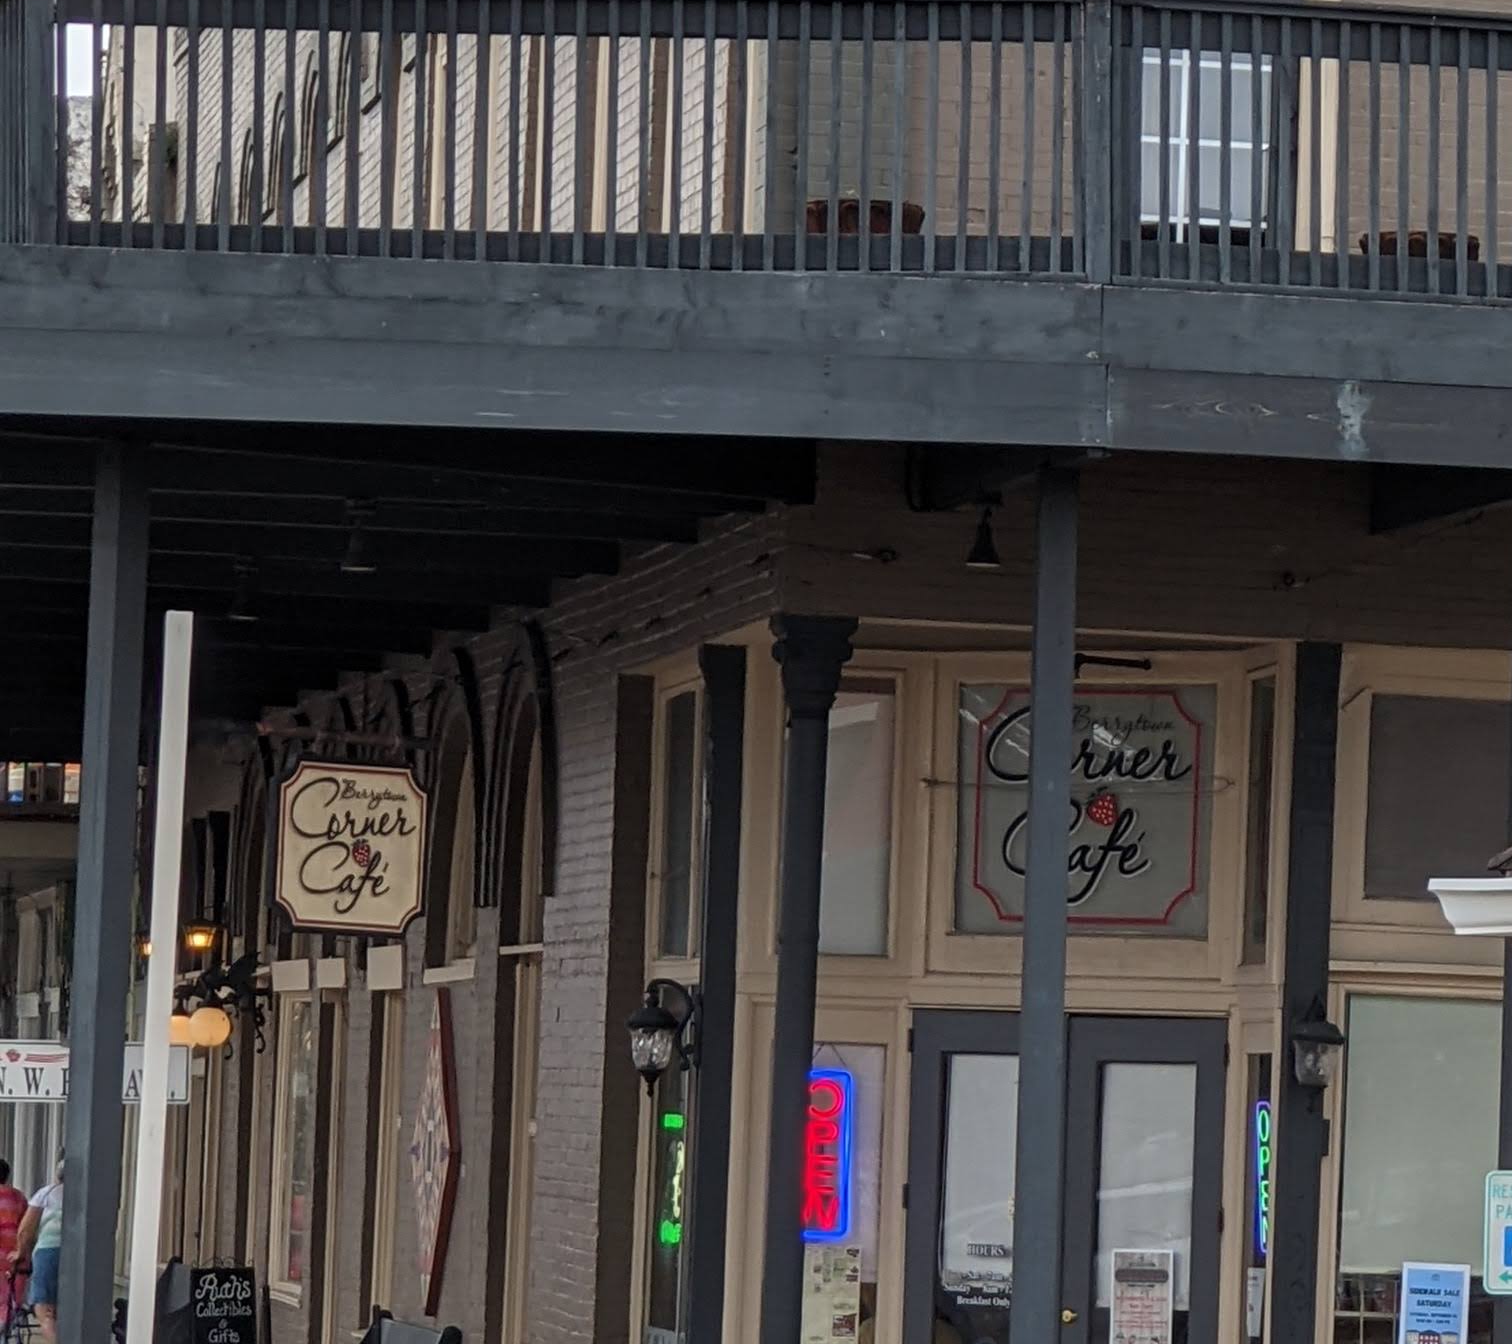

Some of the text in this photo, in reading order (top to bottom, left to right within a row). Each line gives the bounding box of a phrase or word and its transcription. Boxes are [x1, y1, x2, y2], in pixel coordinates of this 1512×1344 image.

[986, 705, 1194, 784] Crner
[290, 776, 417, 840] Corner
[299, 840, 391, 914] Café
[22, 1066, 50, 1096] W.
[802, 1079, 845, 1232] OPEN
[967, 1243, 1004, 1256] HOURS
[208, 1328, 241, 1344] Gifts
